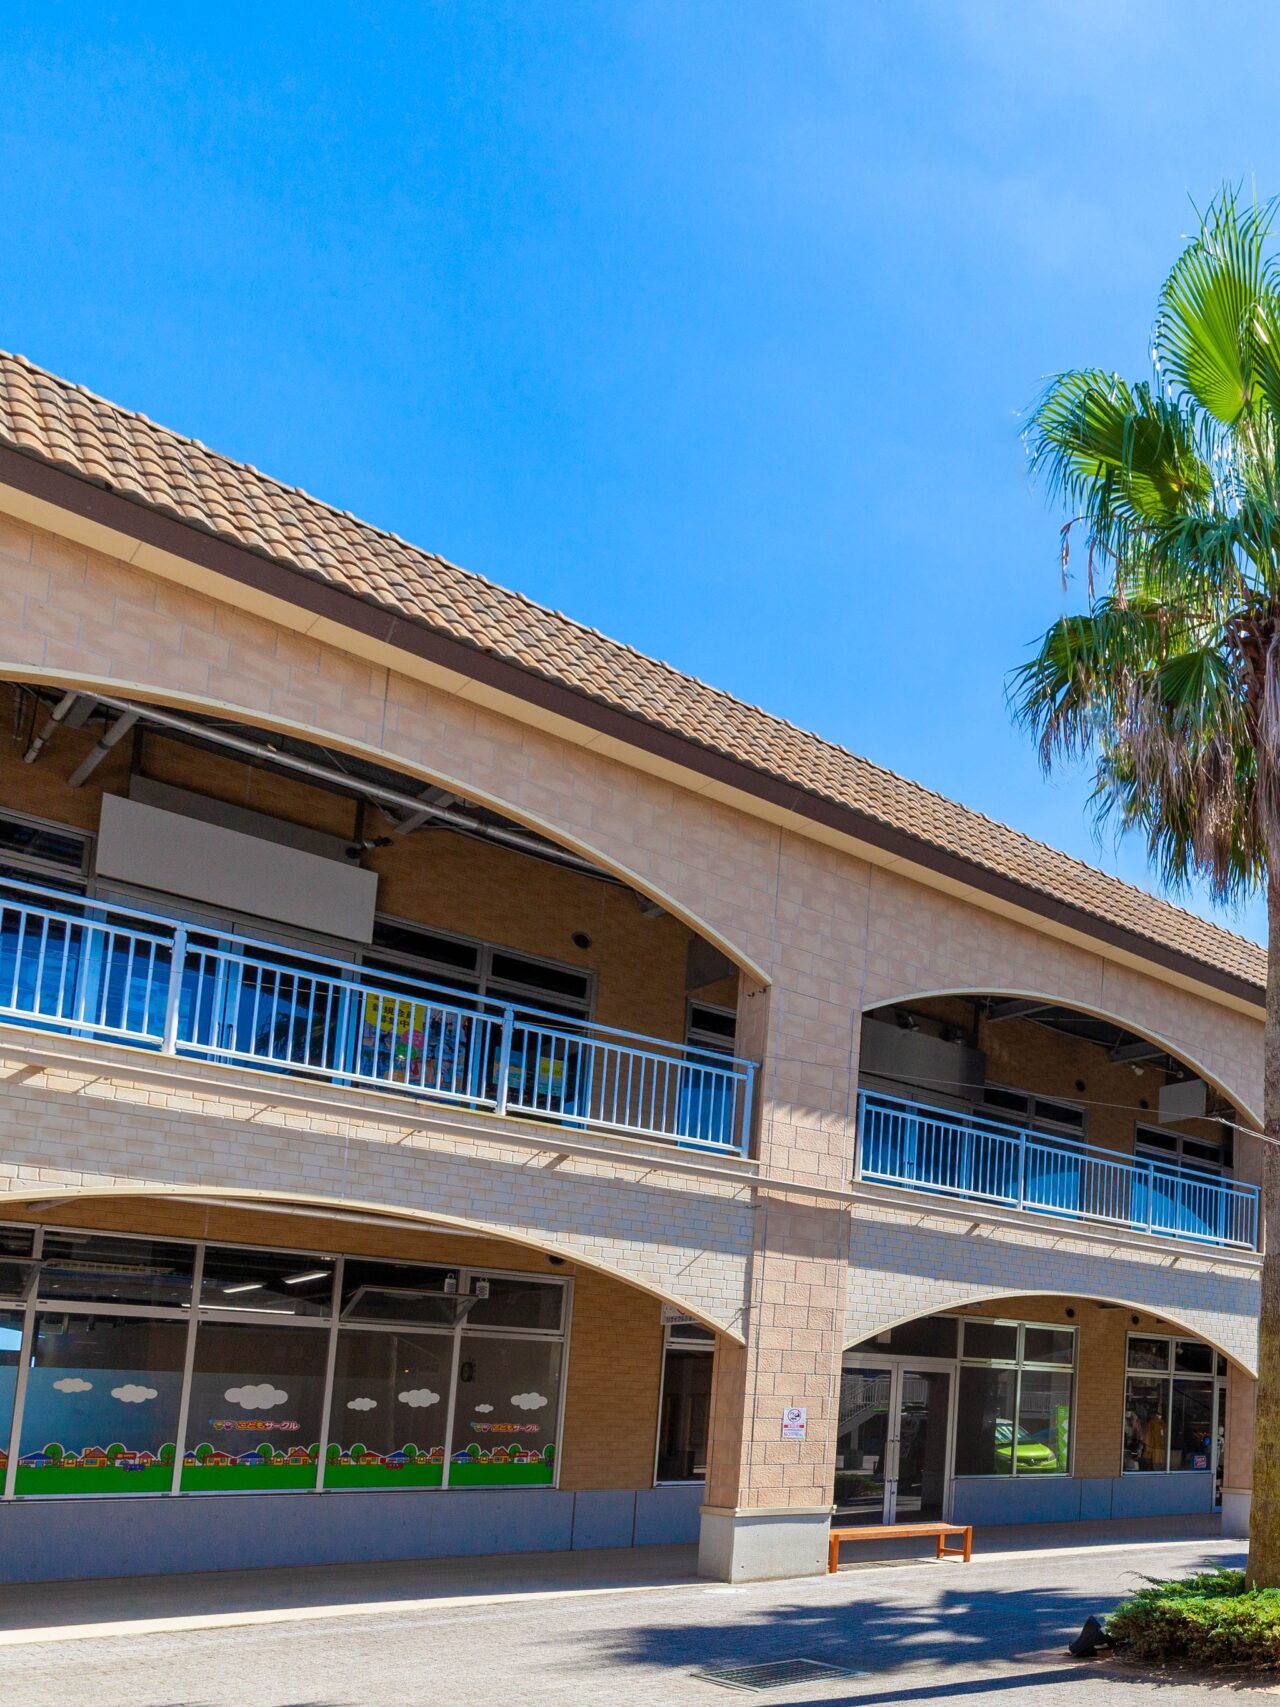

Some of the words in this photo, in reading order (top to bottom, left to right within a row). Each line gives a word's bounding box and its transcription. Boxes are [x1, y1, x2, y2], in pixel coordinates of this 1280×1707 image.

[237, 1420, 300, 1431] こどもサークル
